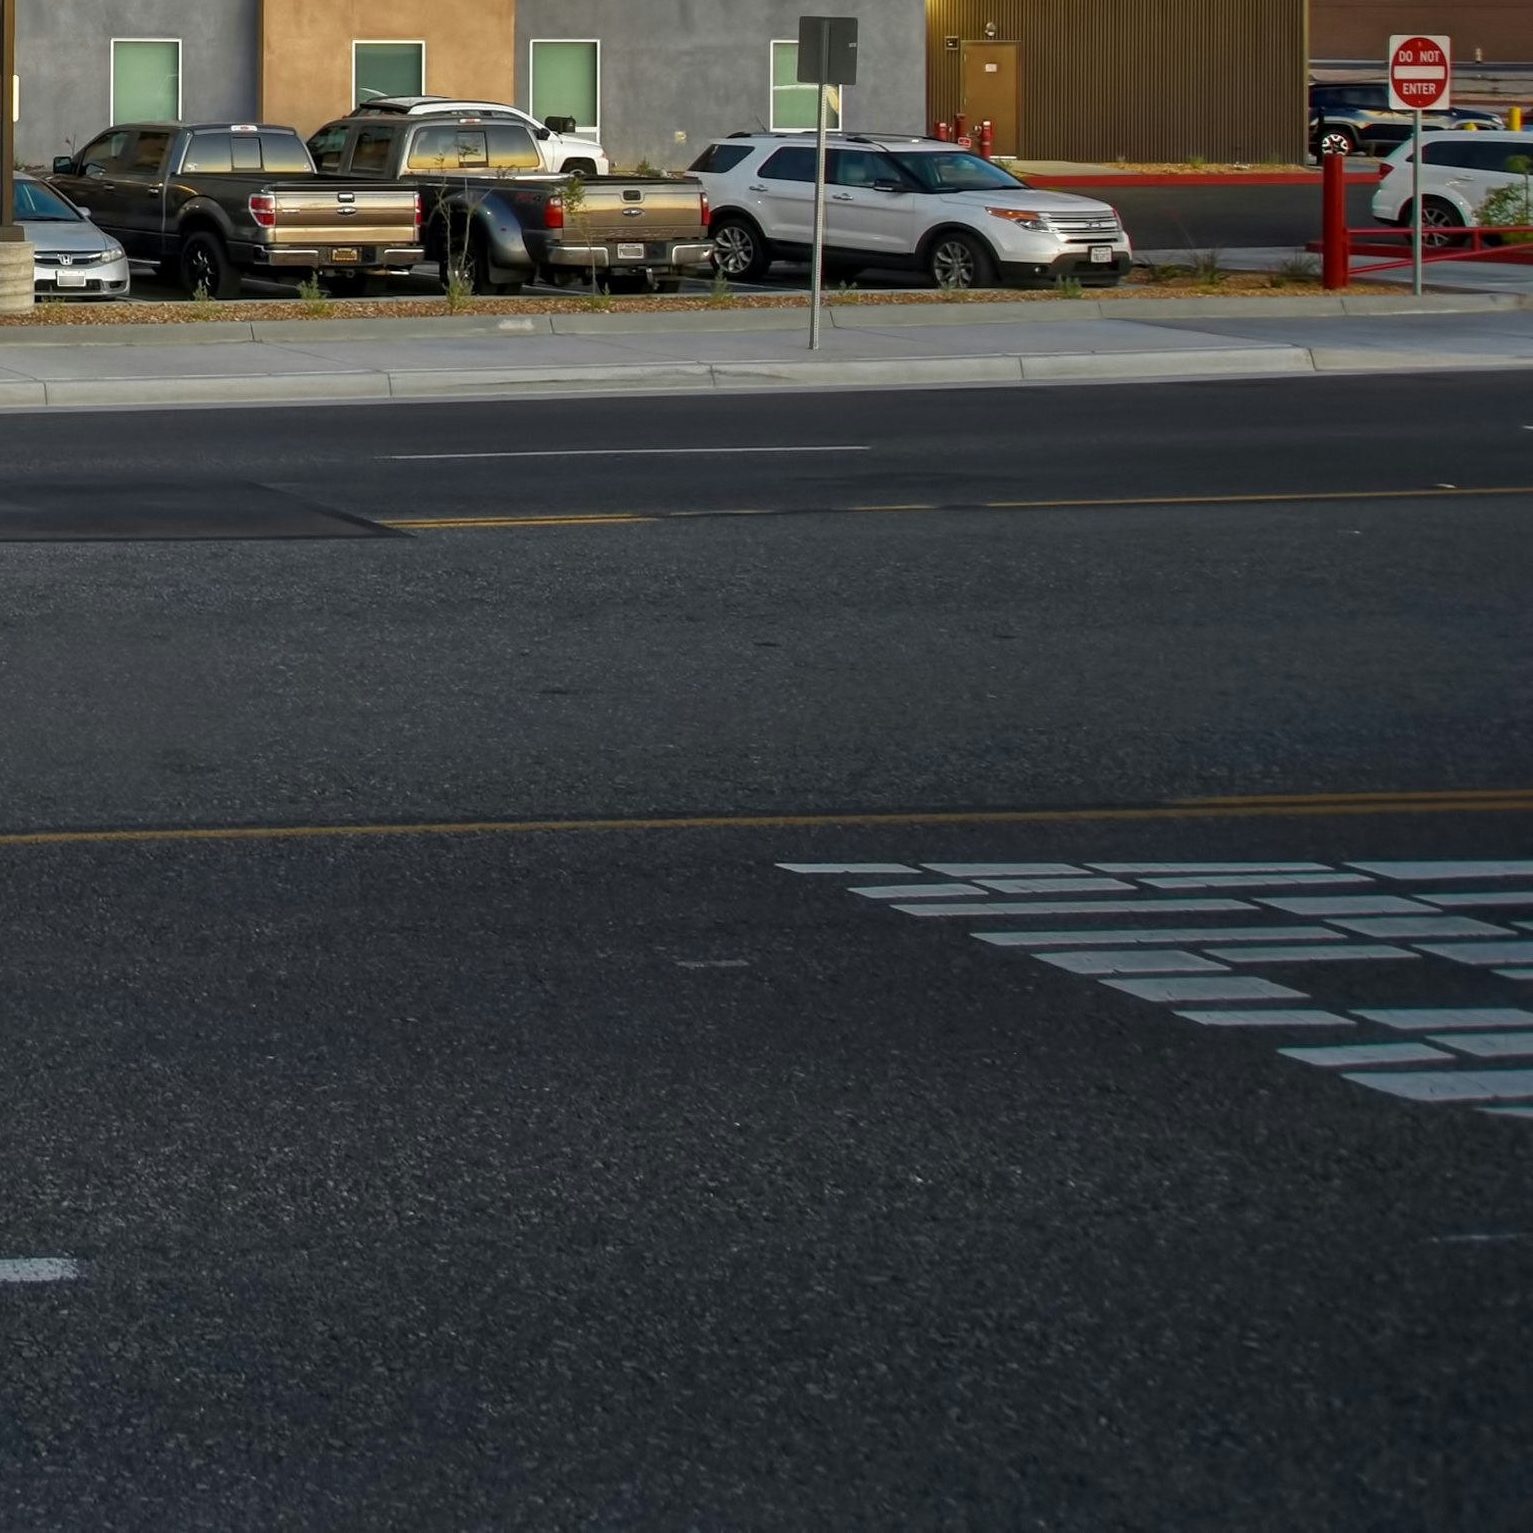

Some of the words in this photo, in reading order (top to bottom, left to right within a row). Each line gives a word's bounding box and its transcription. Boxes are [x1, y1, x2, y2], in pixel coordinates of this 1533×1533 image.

[1398, 50, 1413, 63] DO
[1419, 50, 1440, 63] NOT
[1402, 82, 1436, 95] ENTER
